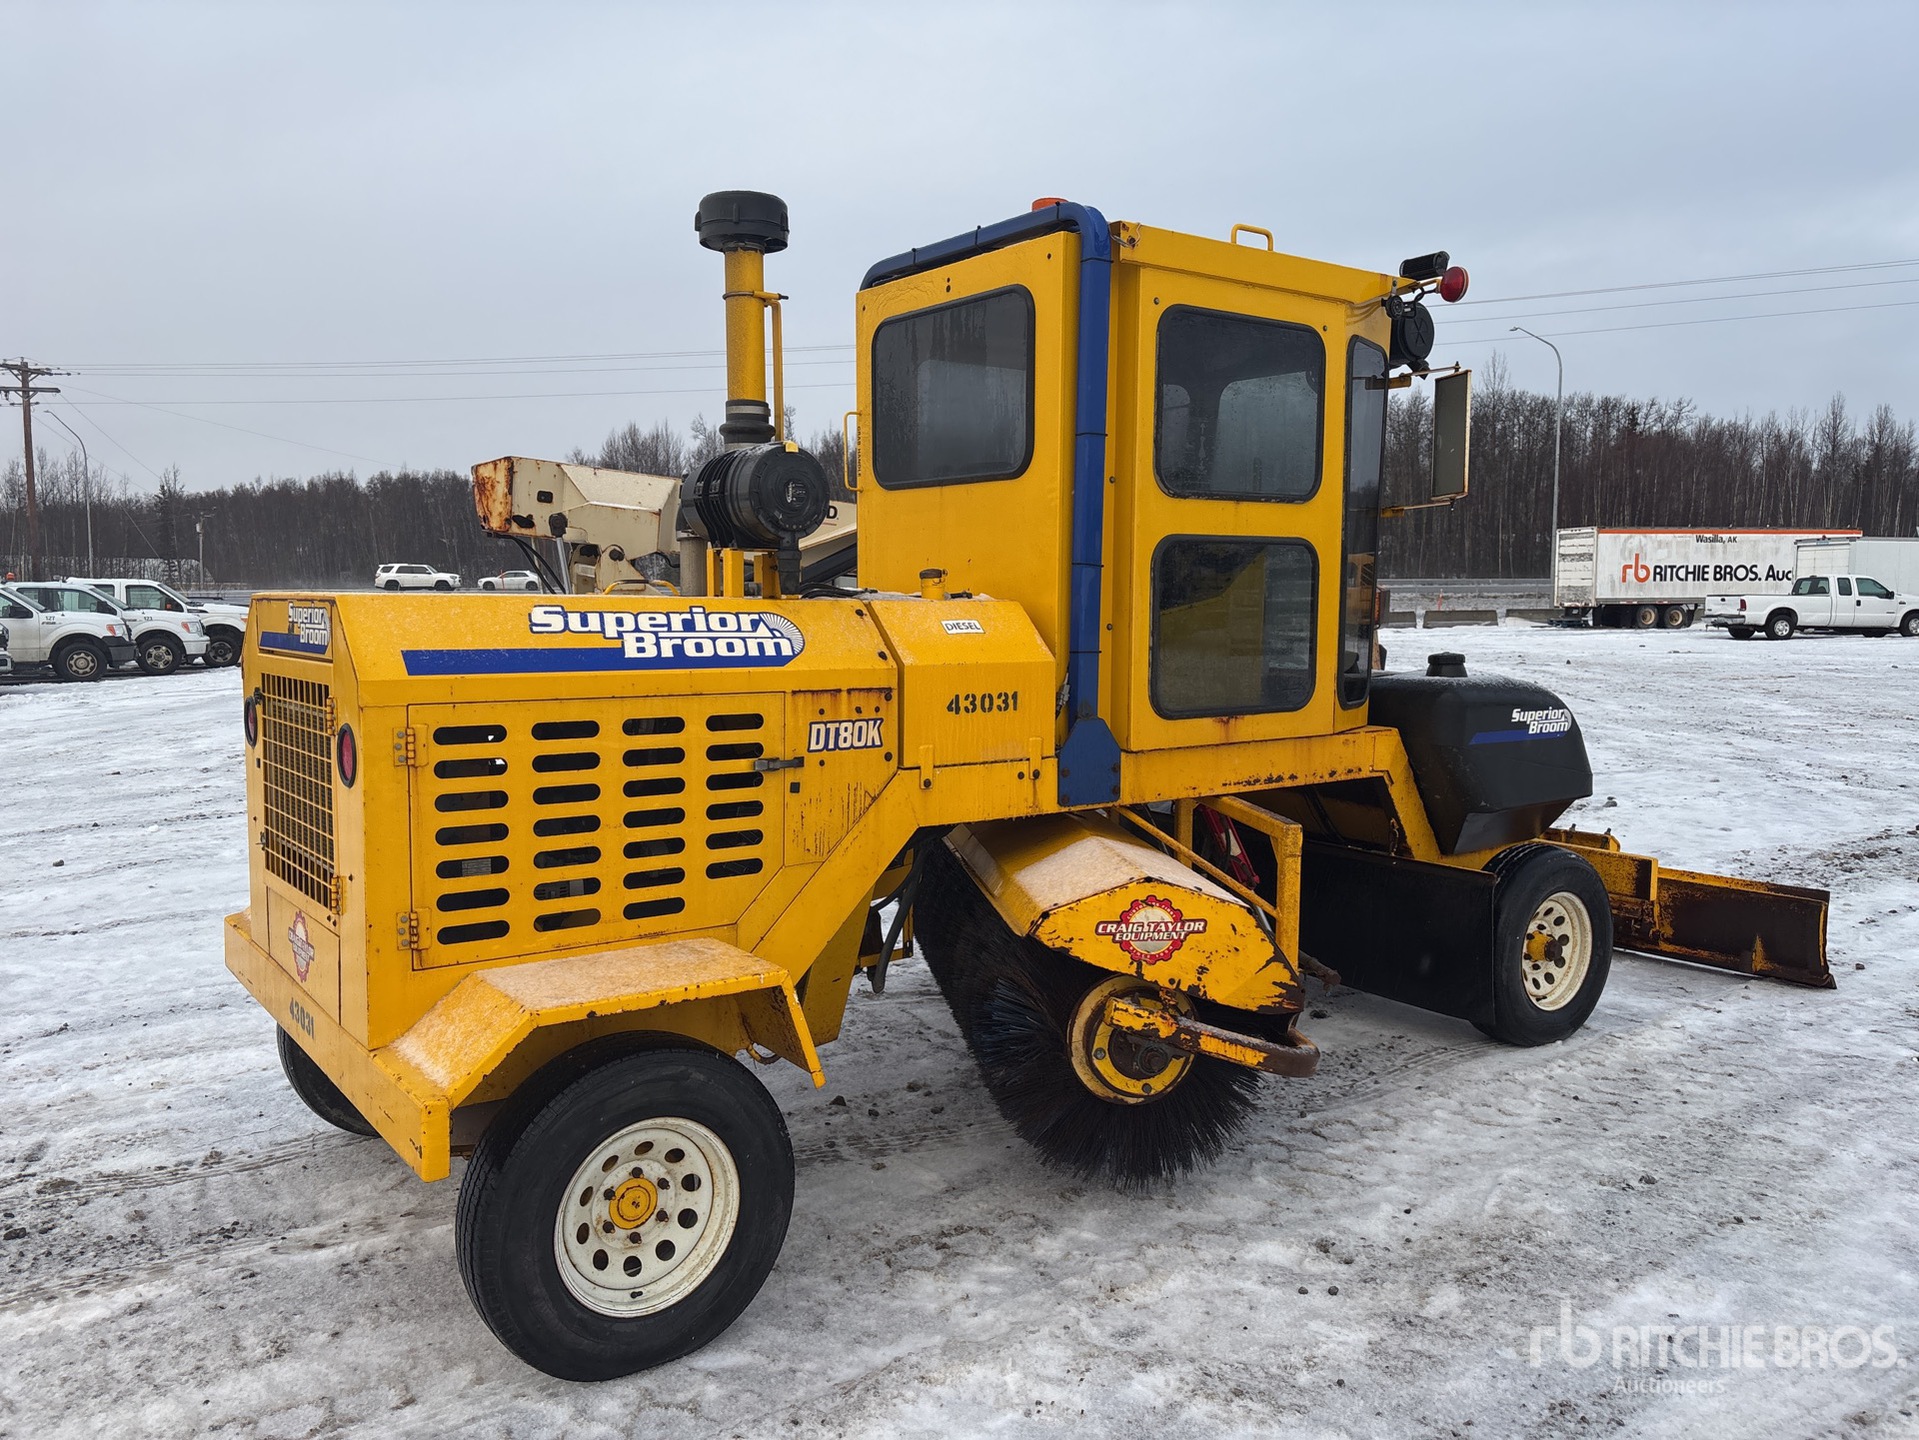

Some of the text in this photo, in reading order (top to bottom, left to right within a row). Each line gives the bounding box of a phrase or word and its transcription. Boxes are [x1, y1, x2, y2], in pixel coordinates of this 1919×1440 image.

[1695, 535, 1726, 544] Wasilla,
[1653, 565, 1710, 582] RITCHIE
[1713, 564, 1762, 582] BROS.
[288, 602, 325, 627] Superior
[531, 605, 760, 638] Superior
[300, 623, 328, 646] Broom
[944, 622, 981, 631] DIESEL
[621, 631, 794, 659] Broom
[946, 691, 1019, 715] 43031
[1511, 706, 1565, 724] Superior
[809, 719, 883, 752] DT80K
[1528, 720, 1569, 734] Broom
[1097, 921, 1205, 934] CRAIG TAYLOR
[1115, 931, 1187, 941] EQUIPMENT
[289, 998, 315, 1040] 43031
